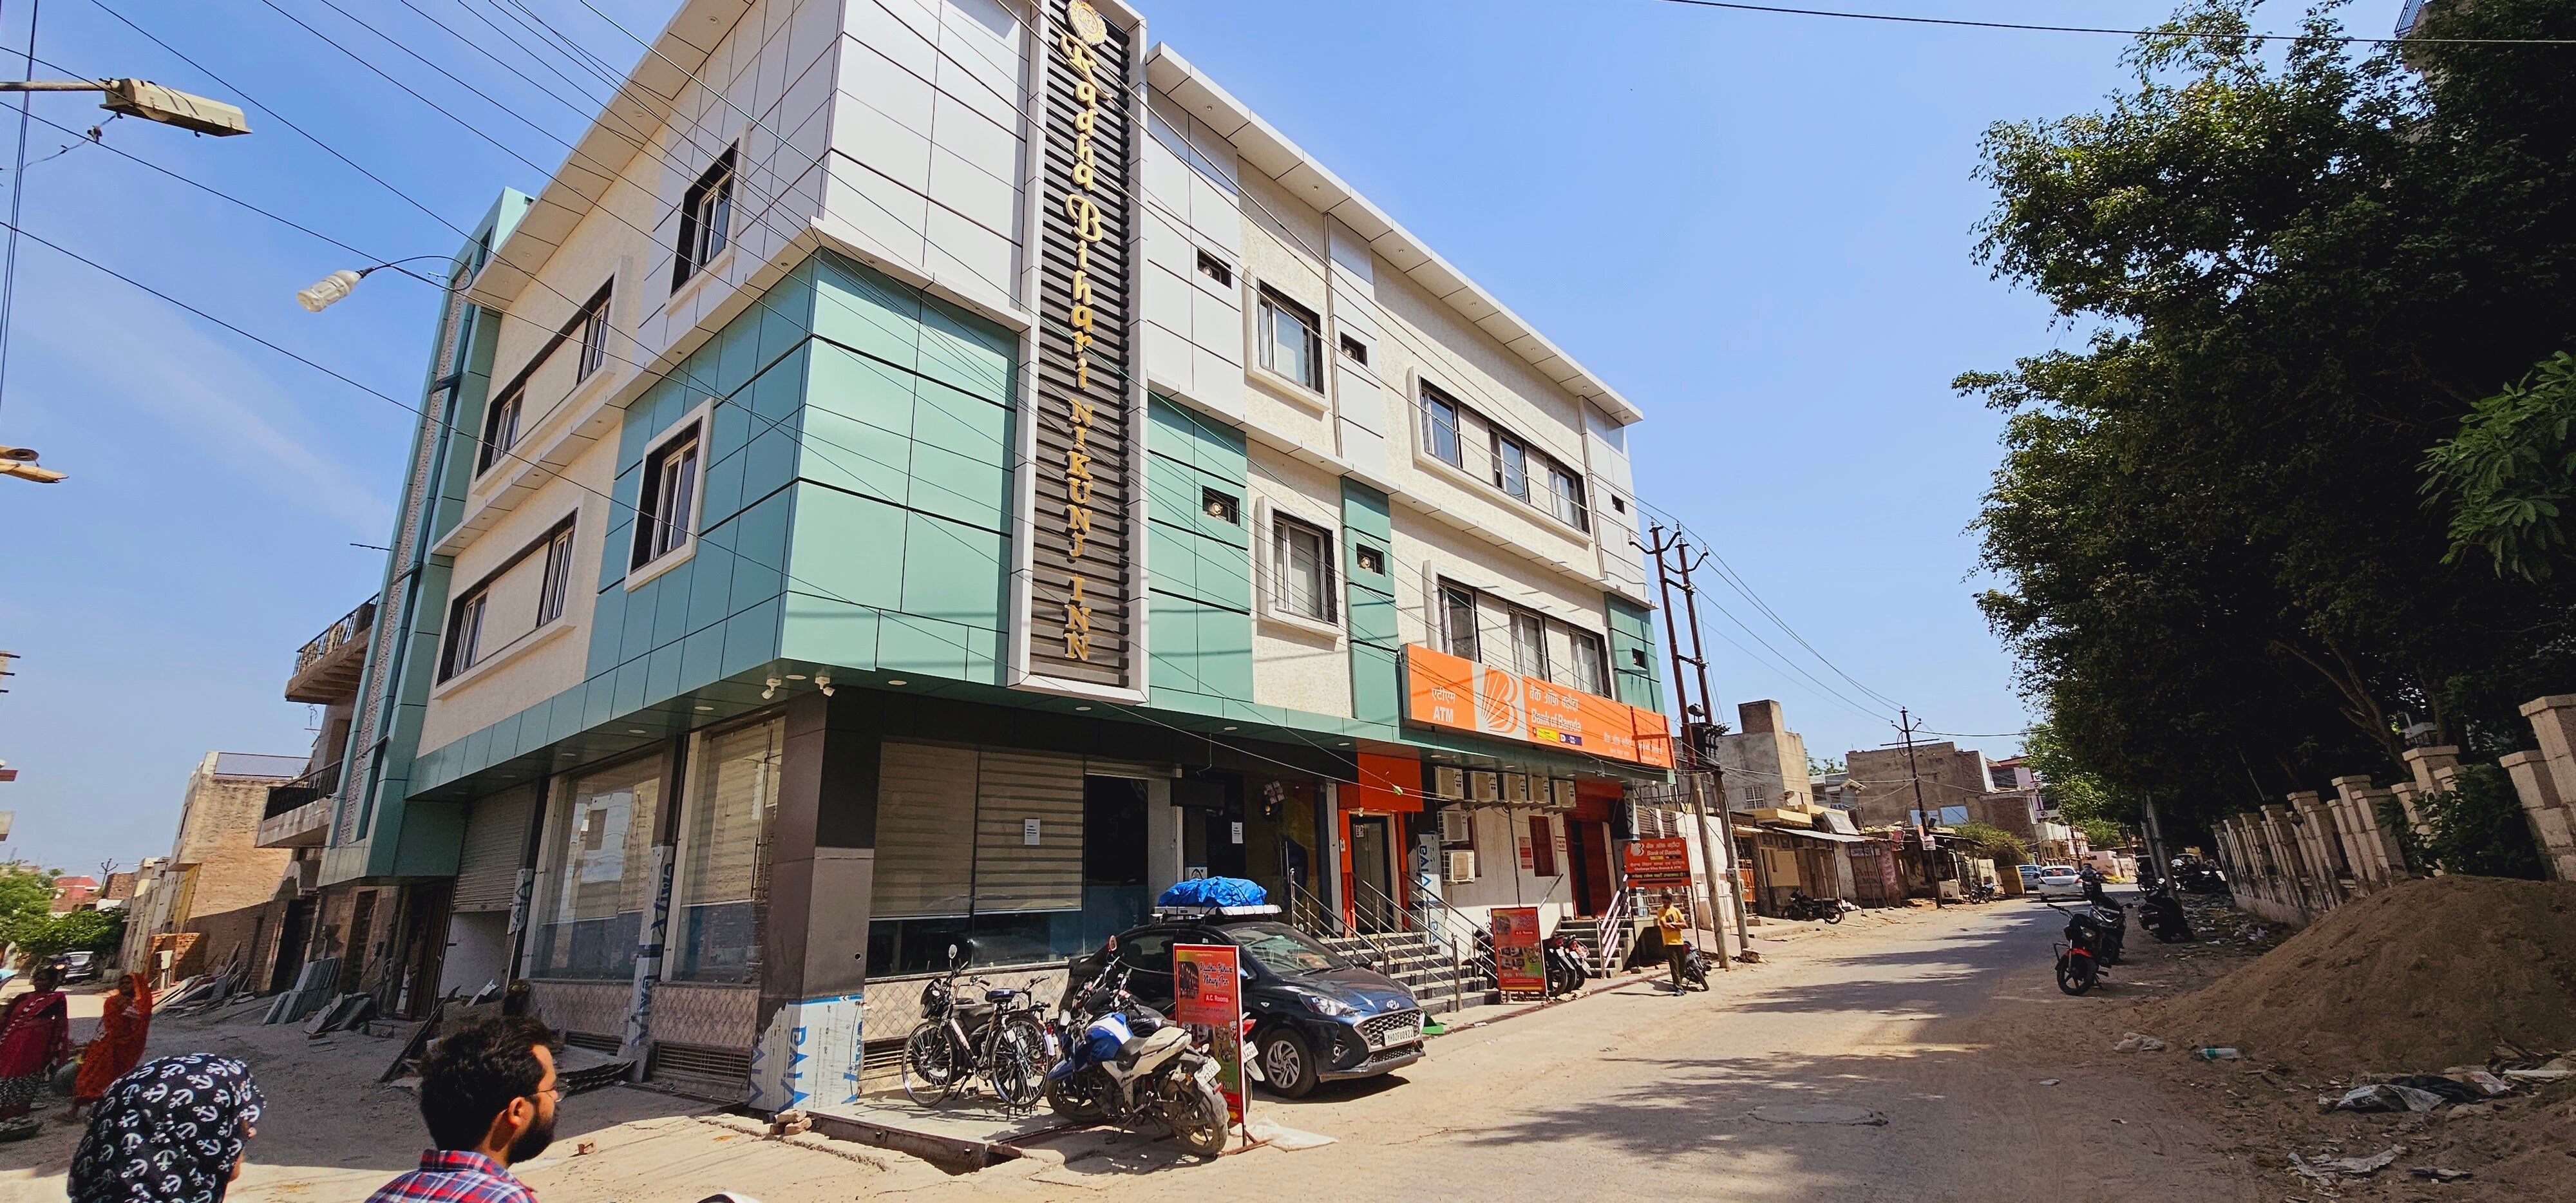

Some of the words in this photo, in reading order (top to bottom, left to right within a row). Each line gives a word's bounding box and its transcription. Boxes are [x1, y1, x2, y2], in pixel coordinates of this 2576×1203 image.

[1060, 34, 1113, 191] Radha
[1065, 194, 1102, 390] Bihari
[1066, 398, 1094, 558] NIKUNJ
[1065, 574, 1092, 661] INN
[1431, 686, 1455, 705] एटीएम
[1433, 705, 1454, 723] ATM
[1531, 707, 1549, 726] Bank
[1550, 712, 1557, 728] of
[1558, 714, 1582, 732] Baroda
